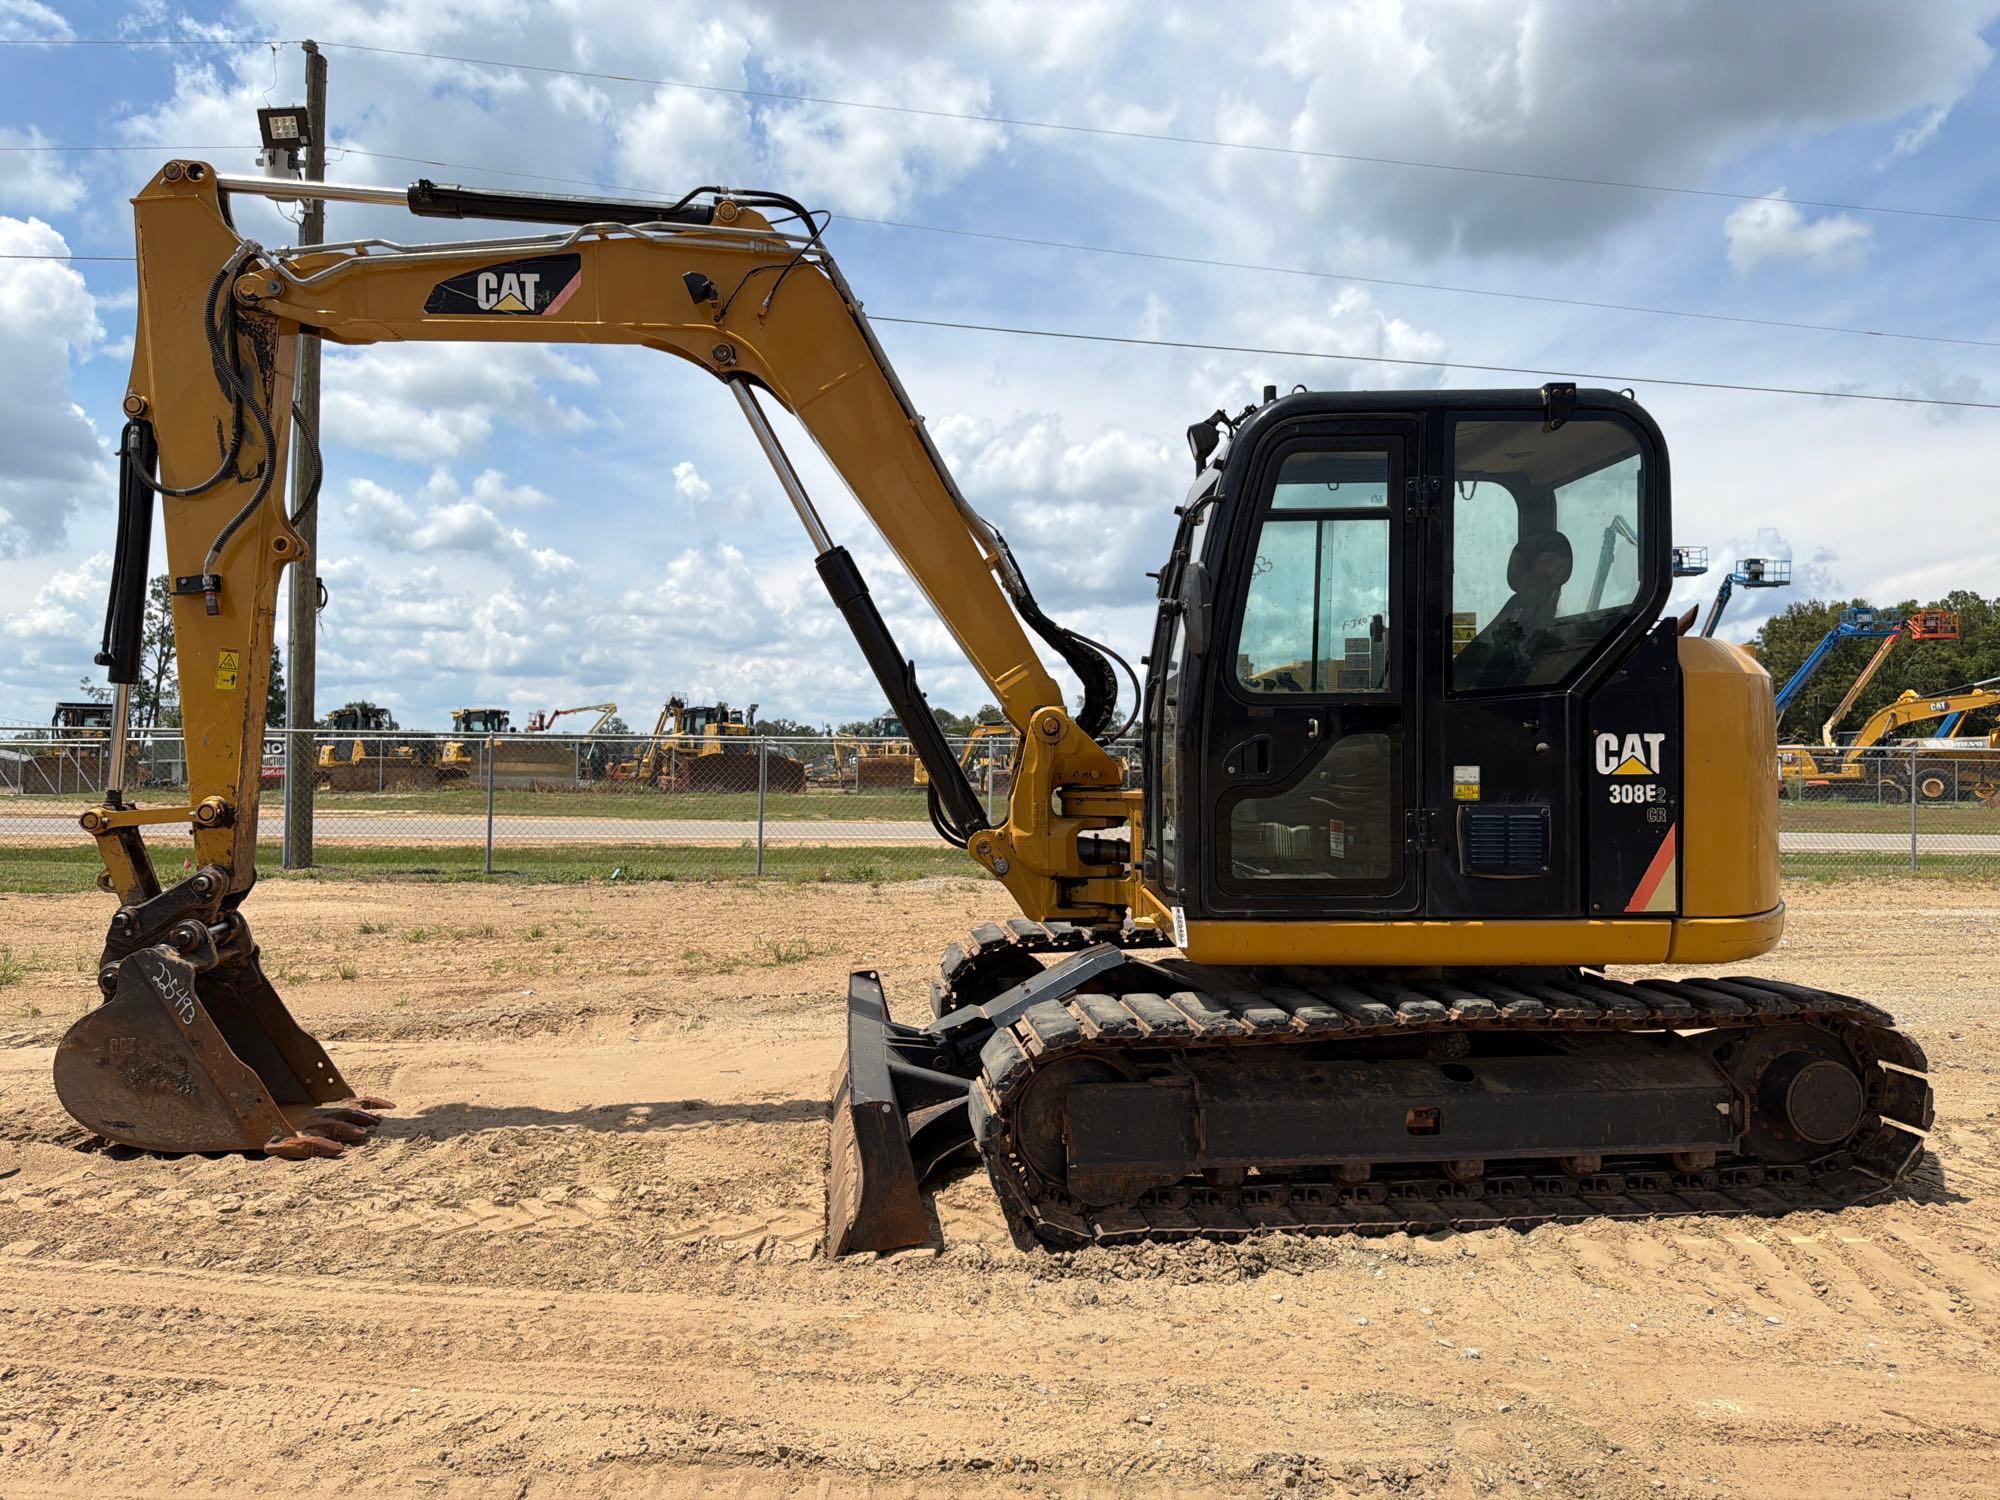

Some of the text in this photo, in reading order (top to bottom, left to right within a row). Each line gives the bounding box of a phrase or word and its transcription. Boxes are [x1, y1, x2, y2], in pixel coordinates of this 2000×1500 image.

[477, 272, 540, 311] CAT
[1930, 701, 1946, 712] CAT
[1595, 732, 1665, 775] CAT
[262, 756, 286, 767] UCTIO
[1646, 807, 1667, 822] CR
